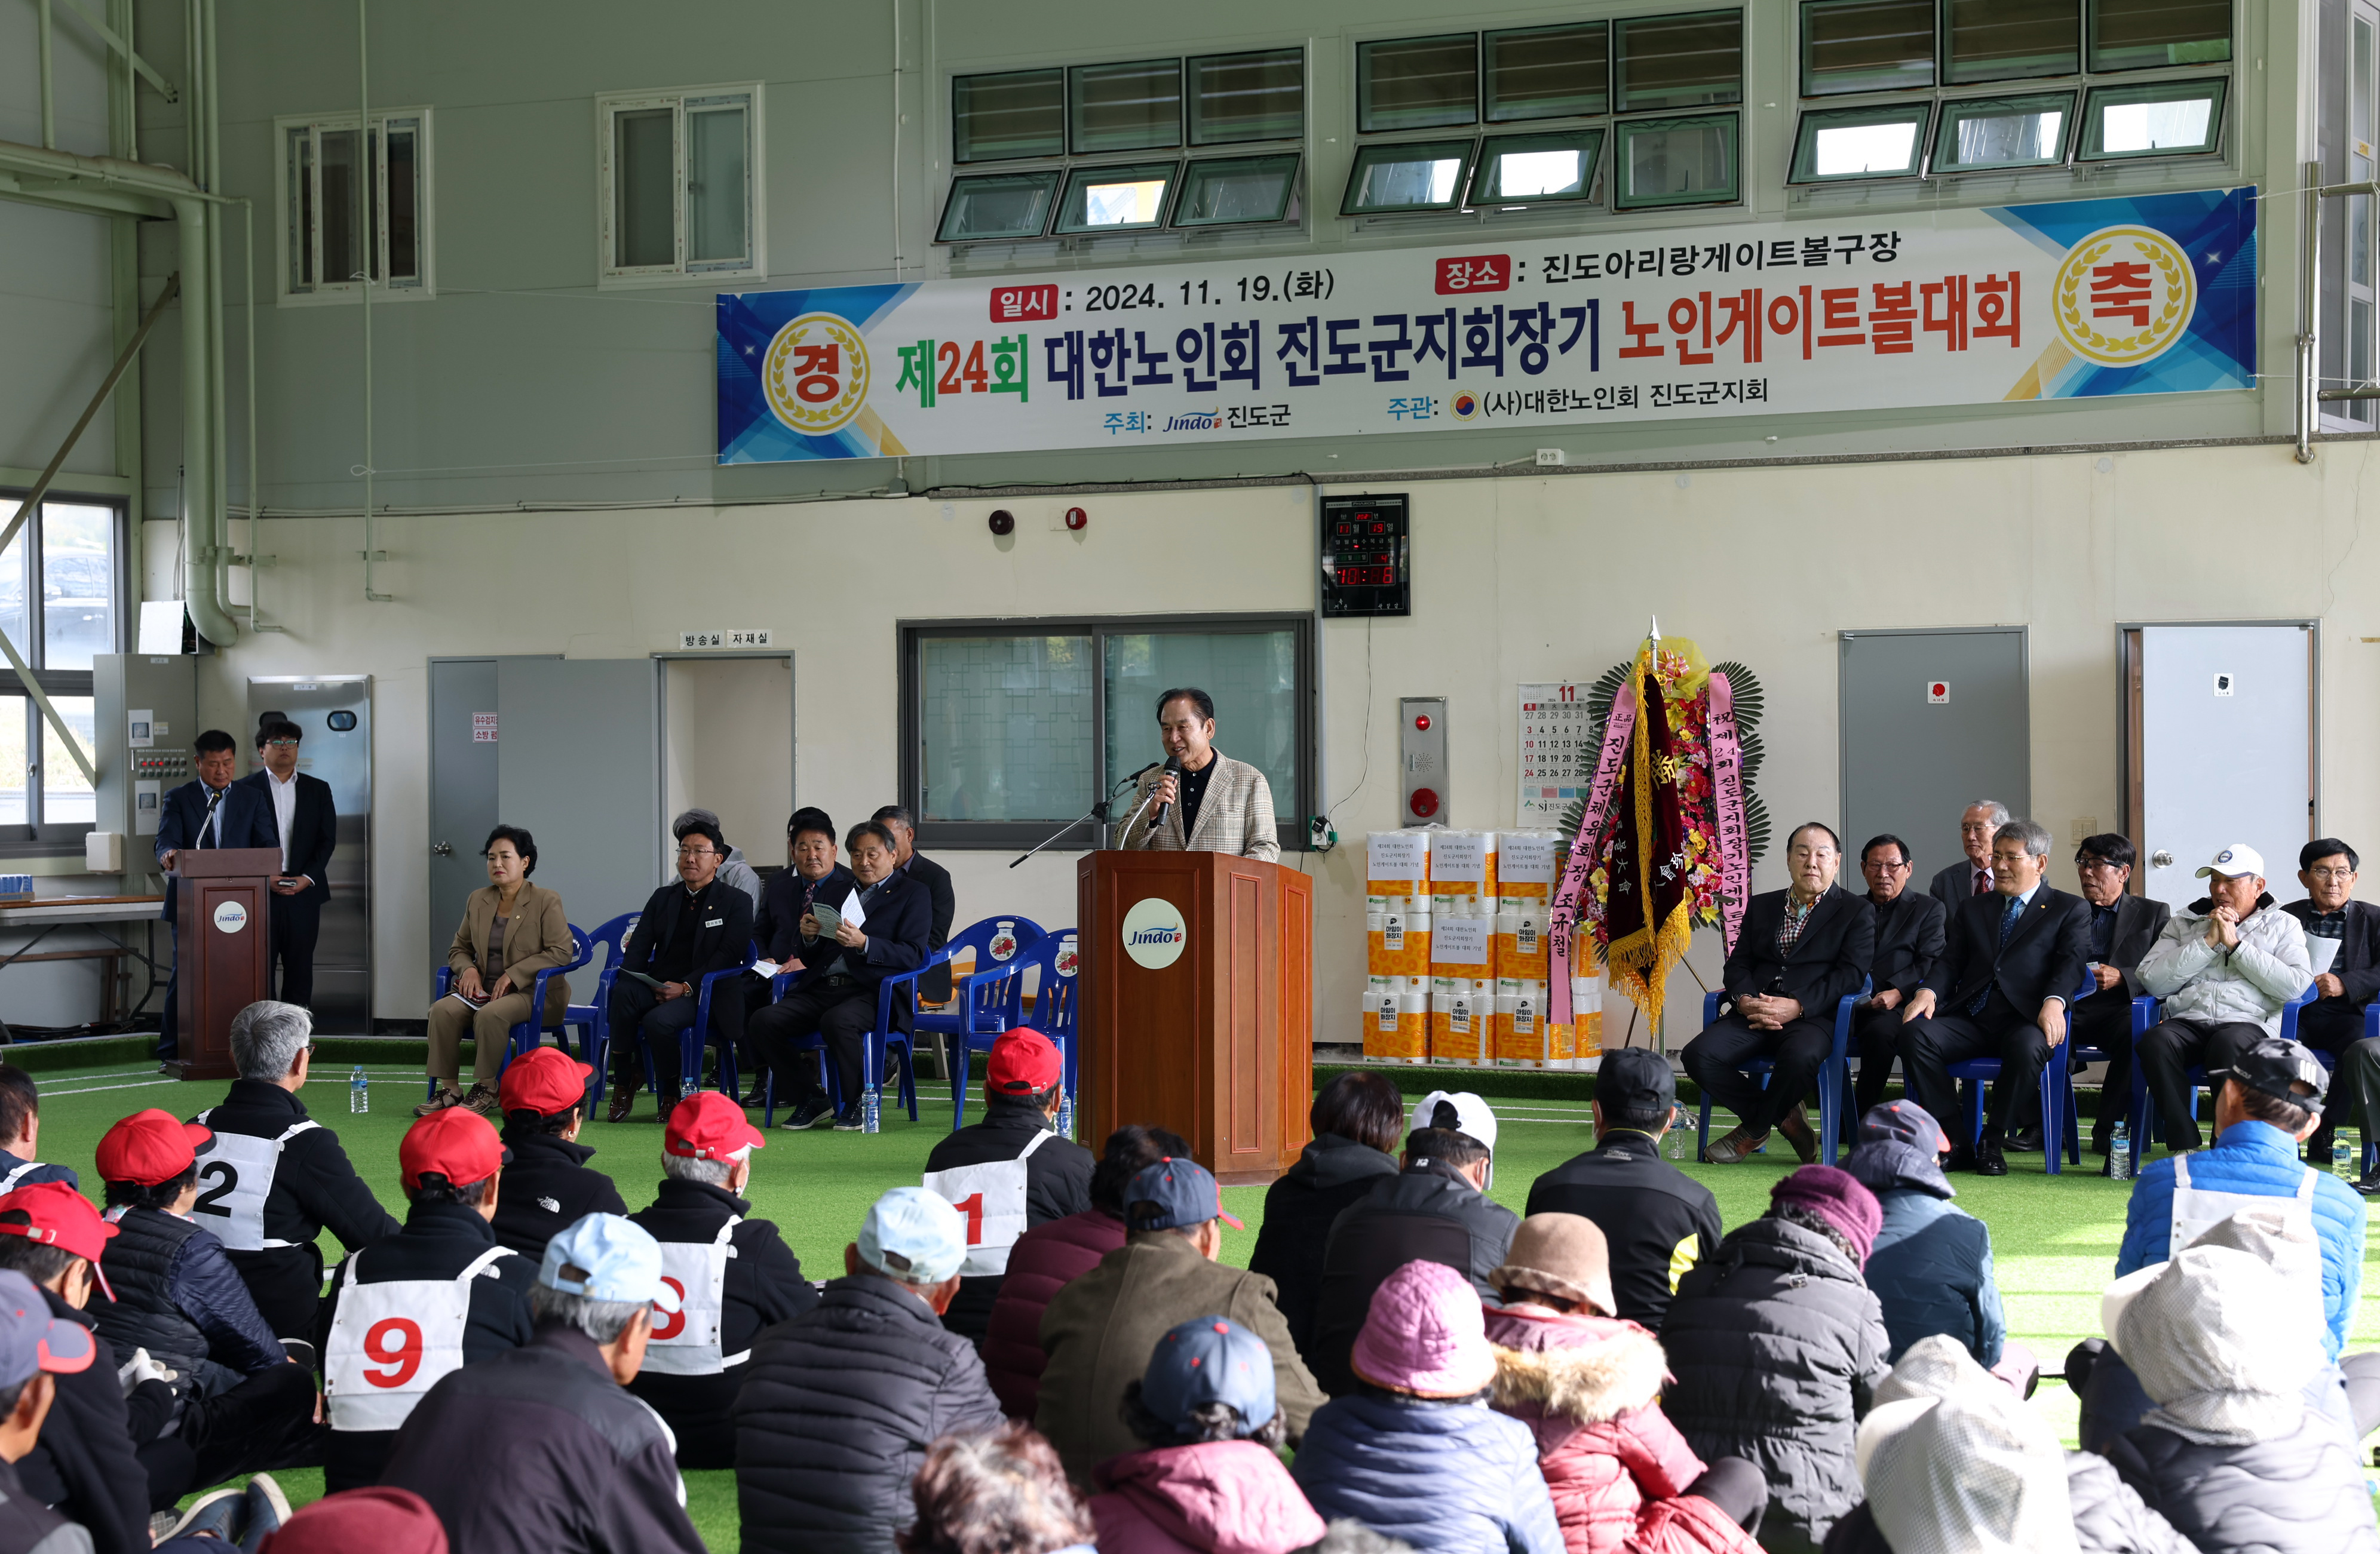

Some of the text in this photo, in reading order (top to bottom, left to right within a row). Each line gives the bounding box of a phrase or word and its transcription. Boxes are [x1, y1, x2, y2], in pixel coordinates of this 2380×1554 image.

[1446, 263, 1501, 289] 장소
[1541, 231, 1901, 284] 진도아리랑게이트볼구장
[1001, 292, 1050, 316] 일시
[1085, 285, 1165, 312] 2024.
[1180, 280, 1221, 308] 11.
[1236, 268, 1335, 303] 19.(화)
[2089, 260, 2153, 328] 축
[895, 270, 2022, 409] 제24회 대한노인회 진도군지회장기 노인게이트볼대회
[791, 342, 841, 404] 경
[1387, 396, 1439, 421] 주관:
[1483, 378, 1768, 416] (사)대한노인회 진도군지회
[1103, 409, 1152, 435] 주최:
[1163, 416, 1212, 432] Jindo
[1227, 404, 1291, 428] 진도군
[1339, 525, 1349, 533] 11
[1373, 523, 1393, 533] 19 일
[686, 634, 719, 646] 방송실
[733, 633, 767, 644] 자재실
[1559, 686, 1574, 702] 11
[1614, 714, 1632, 722] 正品
[1712, 711, 1734, 724] 祝
[476, 730, 489, 739] 소방
[1128, 931, 1173, 945] Jindo
[194, 1160, 239, 1218] 2
[952, 1193, 983, 1245] 1
[363, 1317, 422, 1388] 9
